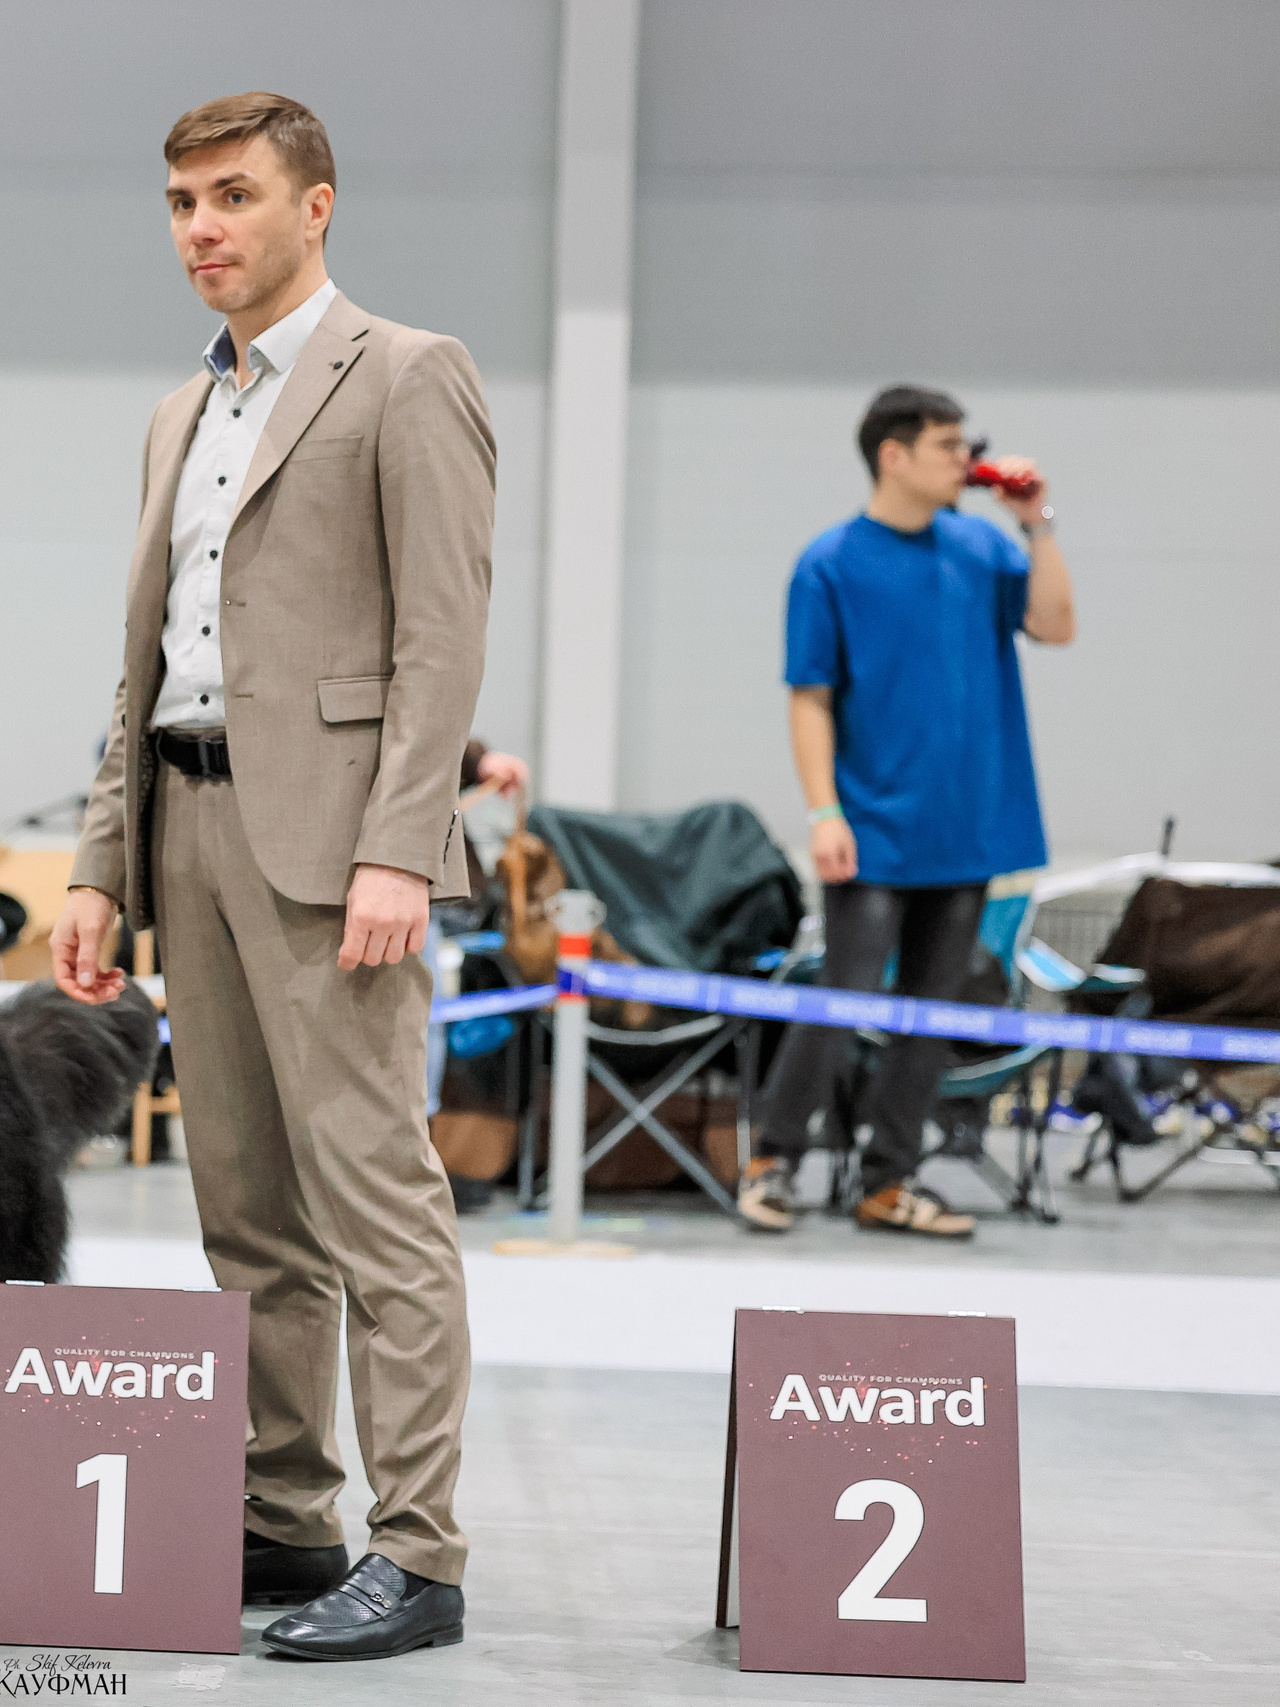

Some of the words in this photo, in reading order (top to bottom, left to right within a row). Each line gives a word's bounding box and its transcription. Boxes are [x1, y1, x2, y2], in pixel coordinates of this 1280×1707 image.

[4, 1347, 216, 1401] Award
[53, 1347, 101, 1356] QUALITY
[103, 1349, 126, 1357] FOR
[129, 1350, 195, 1360] CHAMPIONS
[818, 1373, 866, 1382] QUALITY
[869, 1374, 893, 1383] FOR
[895, 1375, 963, 1385] CHAMPIONS
[769, 1373, 986, 1426] Award
[76, 1453, 128, 1595] 1
[833, 1478, 928, 1623] 2
